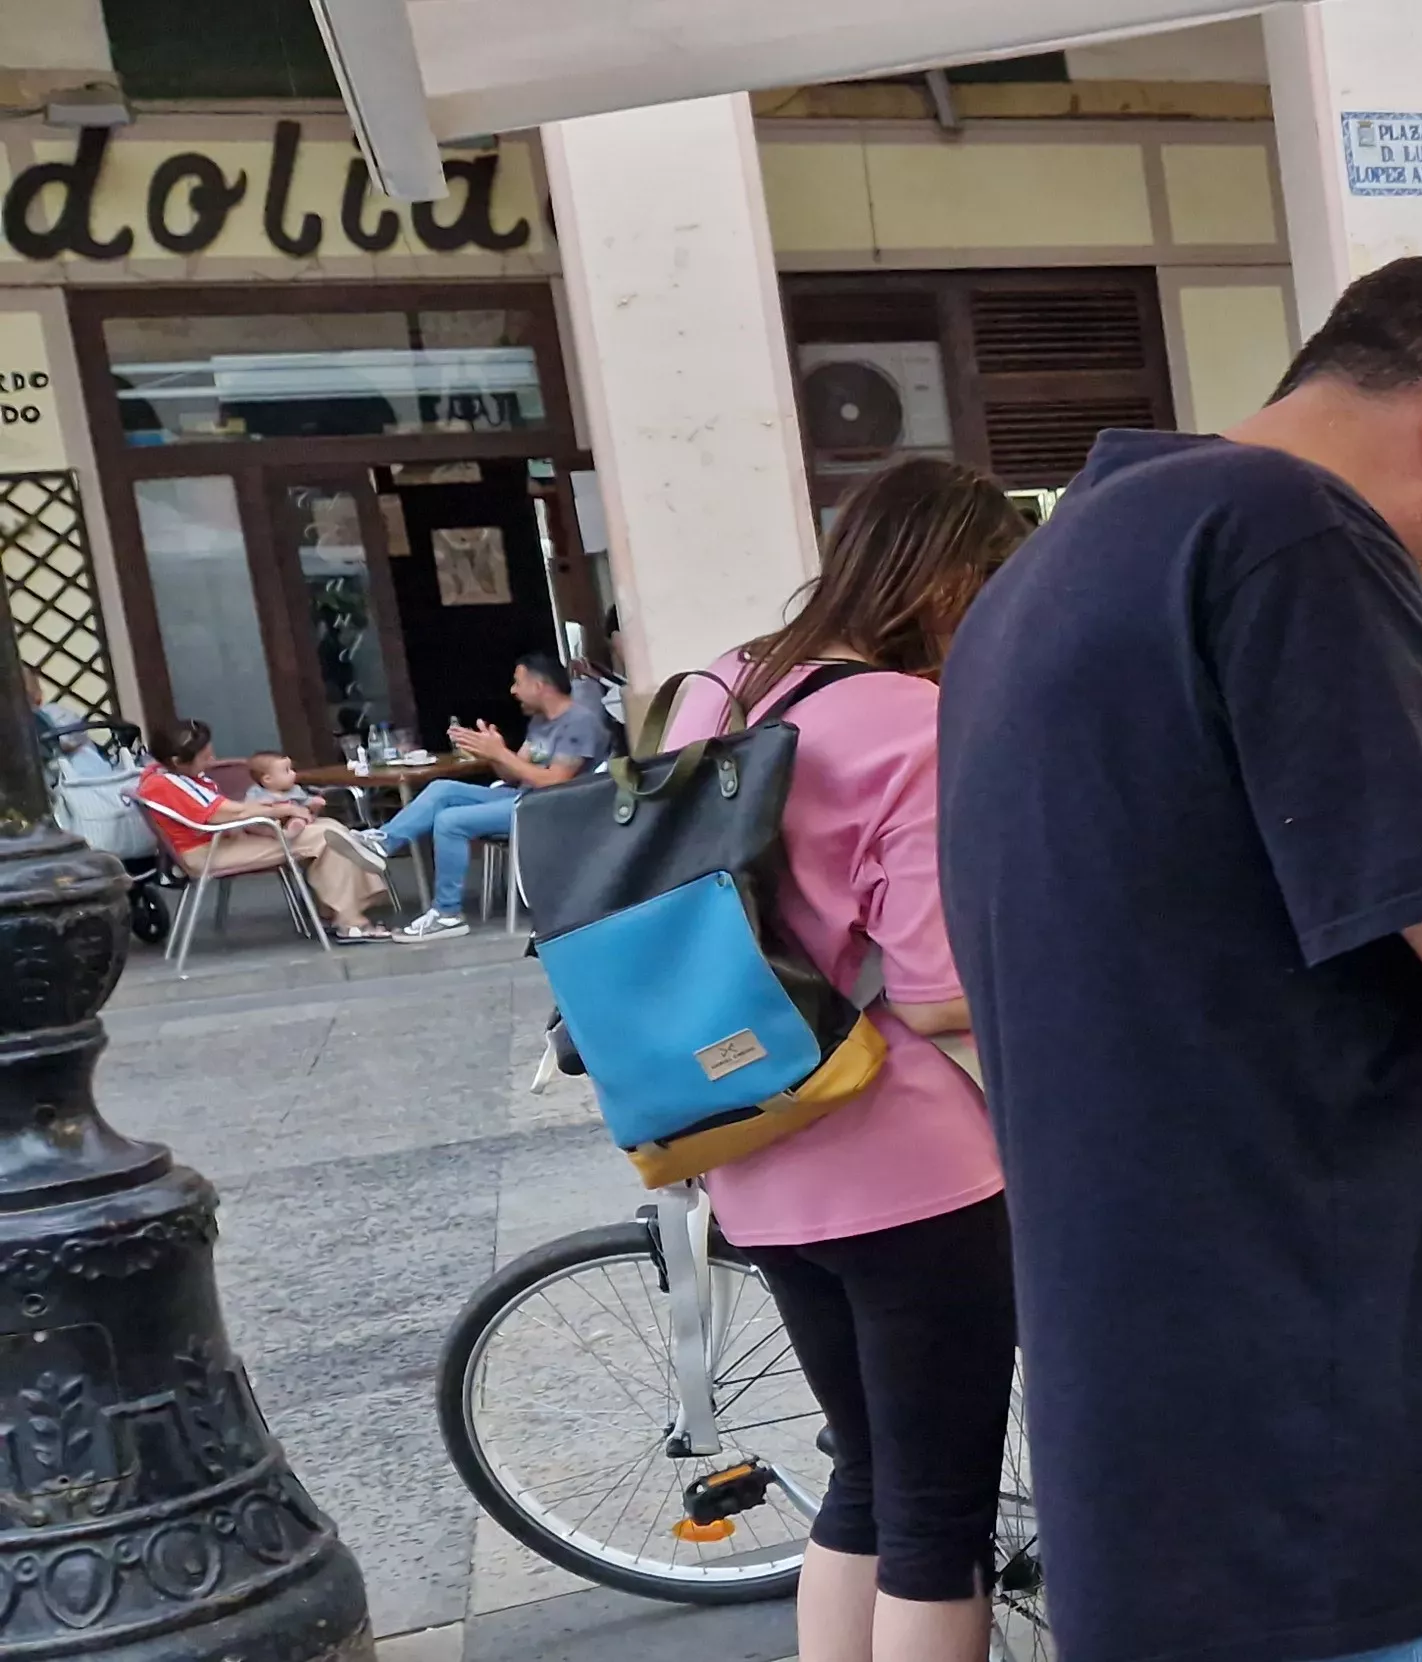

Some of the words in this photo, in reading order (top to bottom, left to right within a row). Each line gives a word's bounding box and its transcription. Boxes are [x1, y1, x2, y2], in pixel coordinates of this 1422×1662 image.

[1381, 145, 1395, 163] D.
[1353, 166, 1407, 183] LOPEZ
[3, 120, 557, 261] dolia
[0, 404, 41, 424] DO
